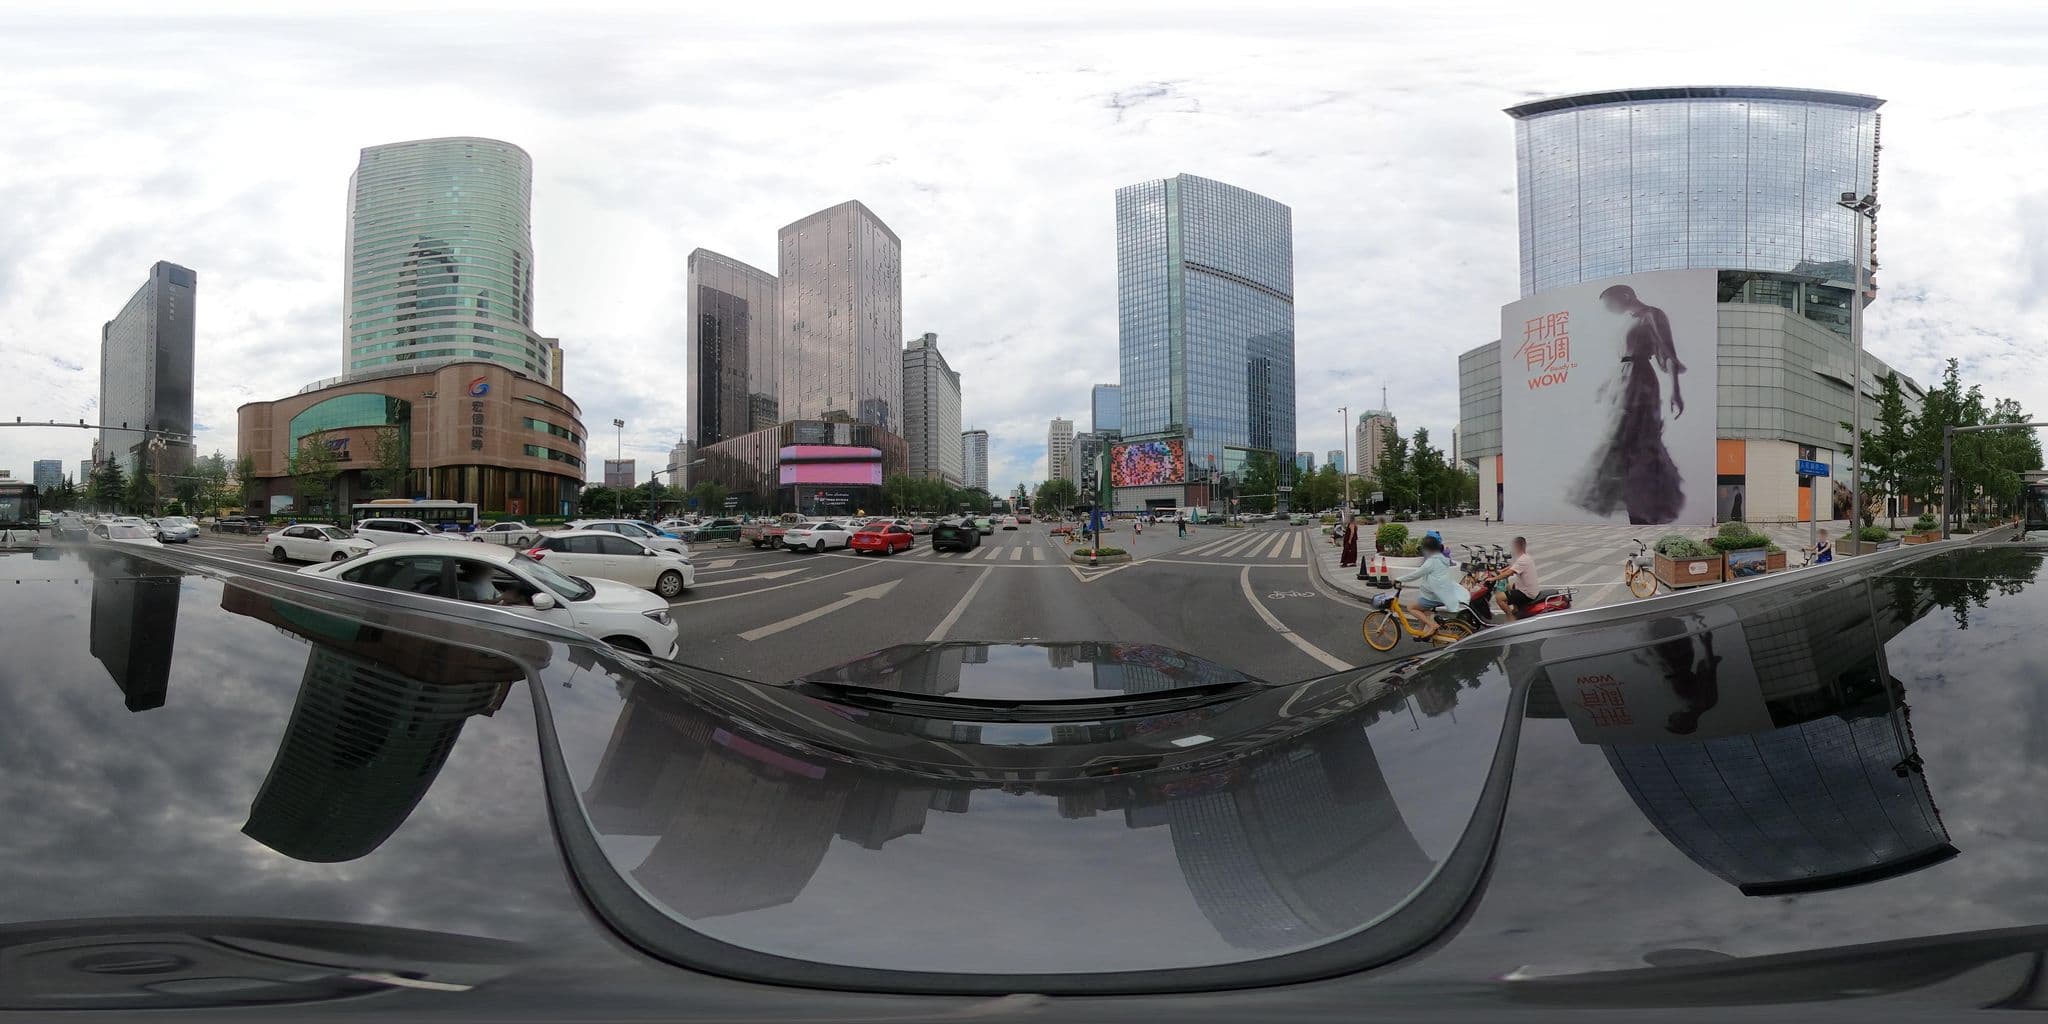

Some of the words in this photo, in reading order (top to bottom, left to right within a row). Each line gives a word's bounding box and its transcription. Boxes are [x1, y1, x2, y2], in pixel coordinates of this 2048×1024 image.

[1513, 310, 1570, 359] 开腔
[1525, 336, 1570, 372] 有调
[1528, 371, 1569, 390] WOW
